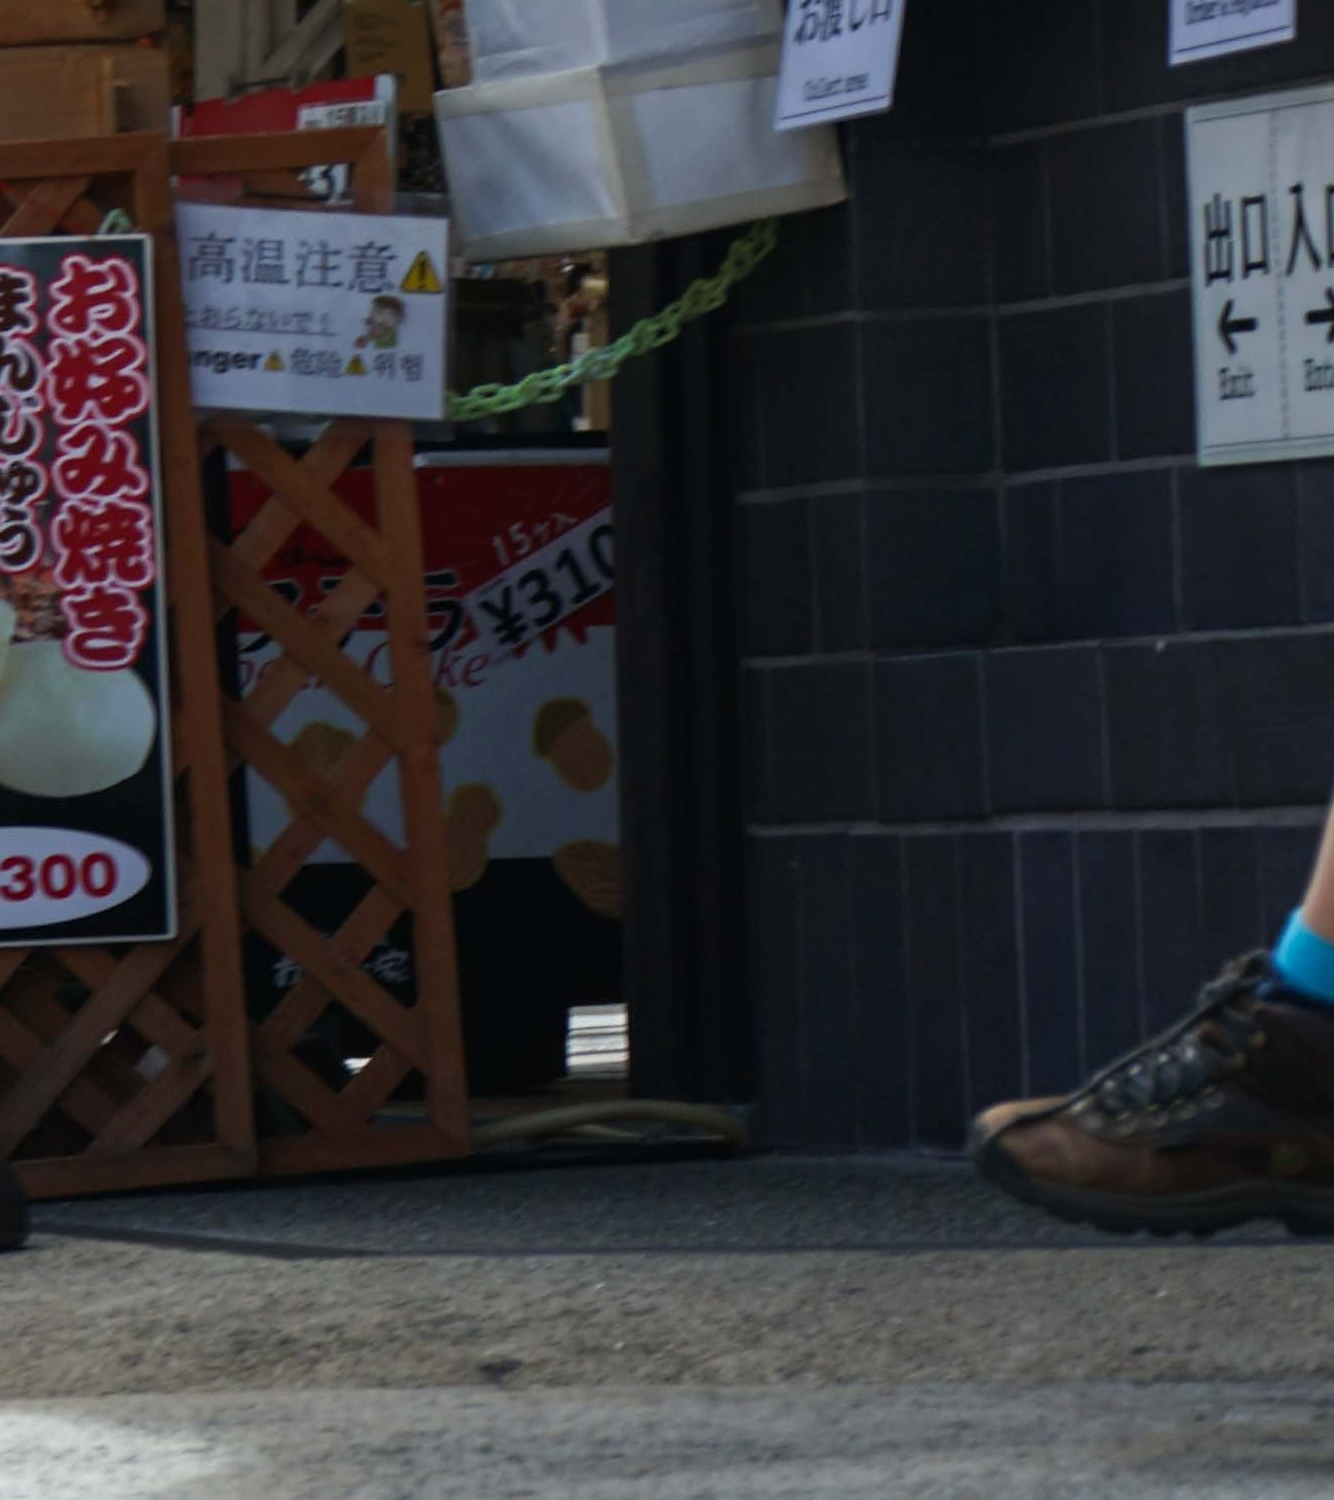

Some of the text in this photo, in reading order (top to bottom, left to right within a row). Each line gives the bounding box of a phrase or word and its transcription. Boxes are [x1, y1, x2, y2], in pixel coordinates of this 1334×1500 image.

[187, 231, 397, 293] 高温注意
[1201, 190, 1271, 285] 出口
[188, 348, 261, 373] nger
[1218, 365, 1256, 401] Exit
[44, 252, 154, 671] お好み焼き
